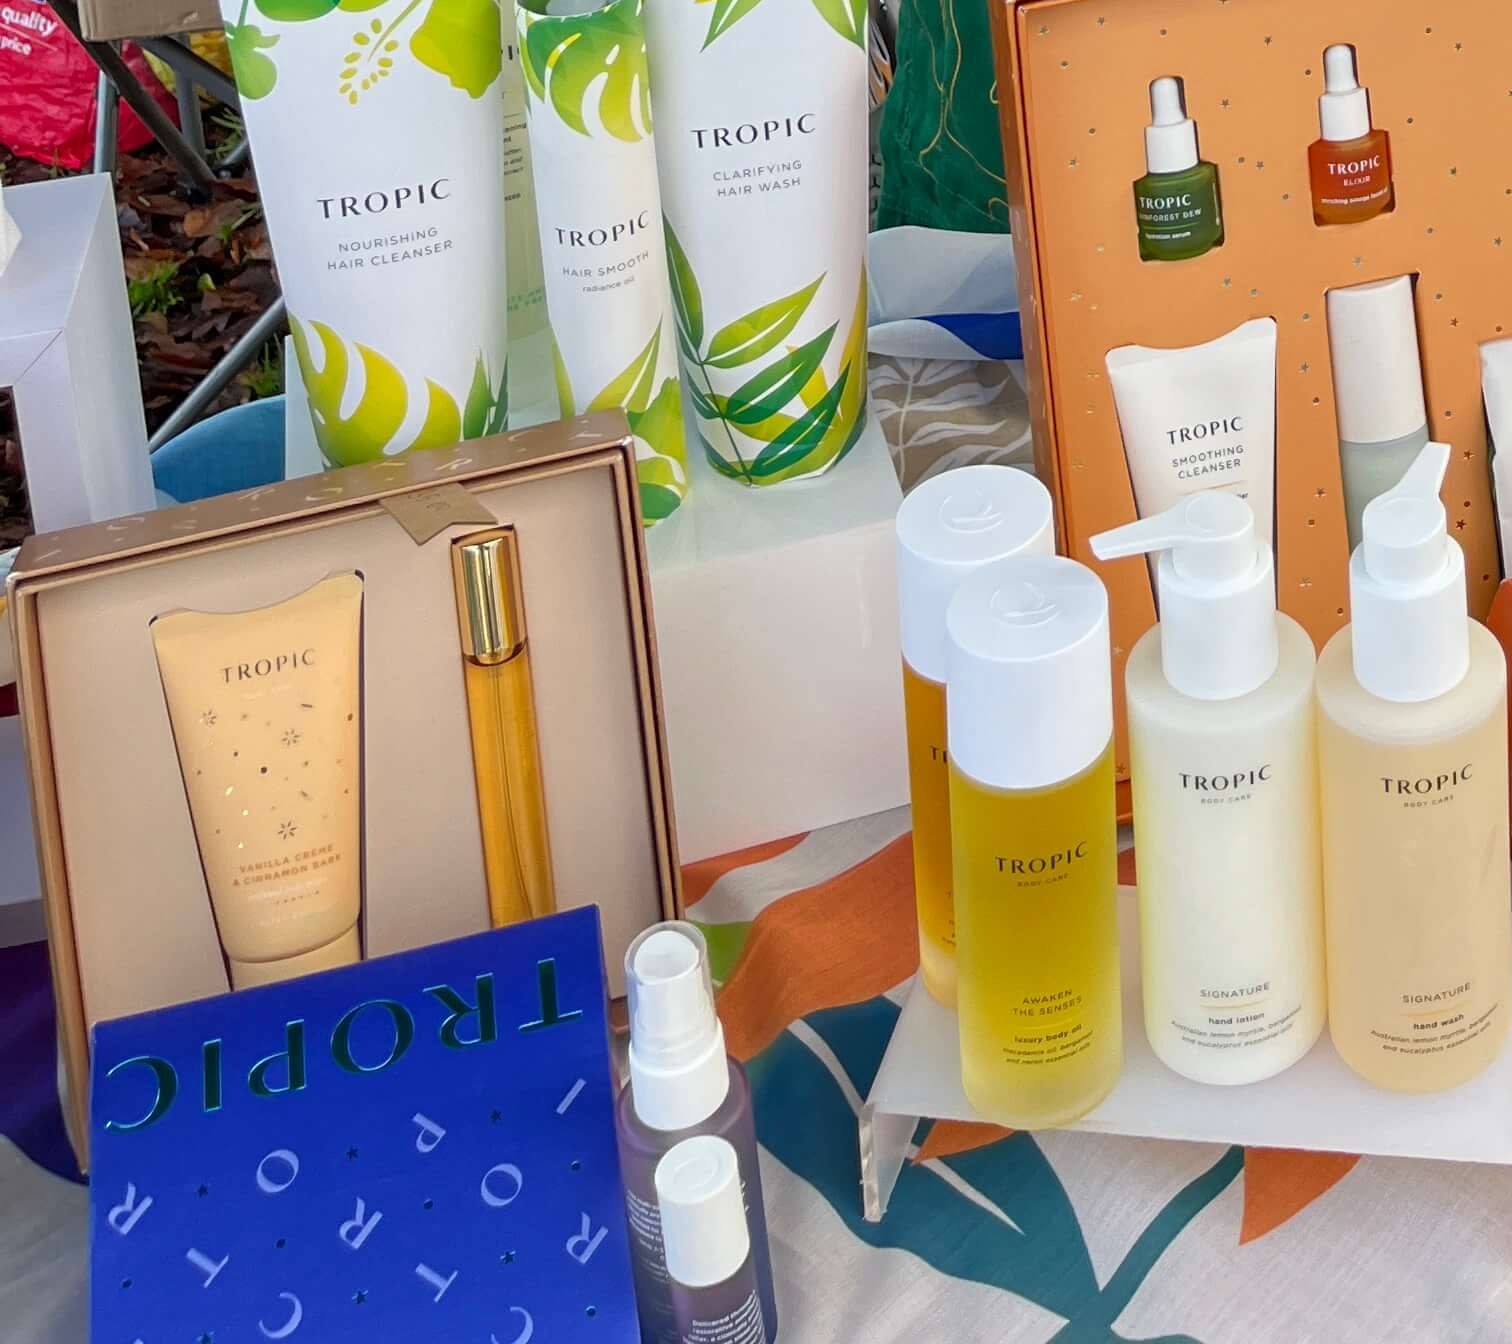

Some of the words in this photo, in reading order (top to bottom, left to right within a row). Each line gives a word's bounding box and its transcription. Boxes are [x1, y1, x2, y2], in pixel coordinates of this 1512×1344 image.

[1, 6, 58, 37] quality
[690, 113, 816, 149] TROPIC
[713, 159, 803, 182] CLARIFYING
[1327, 154, 1382, 175] TROPIC
[317, 178, 452, 220] TROPIC
[717, 185, 753, 198] HAIR
[759, 177, 802, 193] WASH
[1139, 193, 1193, 211] TROPIC
[338, 227, 439, 254] NOURISHING
[554, 210, 650, 248] TROPIC
[327, 256, 364, 271] HAIR
[370, 239, 454, 267] CLEANSER
[562, 266, 593, 279] HAIR
[598, 252, 650, 277] SMOOTH
[1166, 416, 1244, 445] TROPIC
[1172, 444, 1244, 468] SMOOTHING
[1177, 458, 1242, 480] CLEANSER
[220, 647, 317, 684] TROPIC
[1179, 763, 1272, 792] TROPIC
[1381, 763, 1474, 795] TROPIC
[1403, 800, 1429, 809] BODY
[1431, 793, 1455, 807] CARE
[240, 856, 290, 873] VANILLA
[995, 840, 1089, 875] TROPIC
[1022, 988, 1073, 1006] AWAKEN
[1200, 981, 1271, 999] SIGNATURE
[1402, 981, 1472, 1004] SIGNATURE
[1011, 1006, 1035, 1017] THE
[1040, 995, 1083, 1016] SENSES
[1208, 1016, 1233, 1025] hand
[1236, 1012, 1265, 1025] lotion
[1413, 1021, 1438, 1031] hand
[1441, 1013, 1465, 1027] wash
[103, 956, 585, 1133] TROPIC
[1046, 1030, 1069, 1042] body
